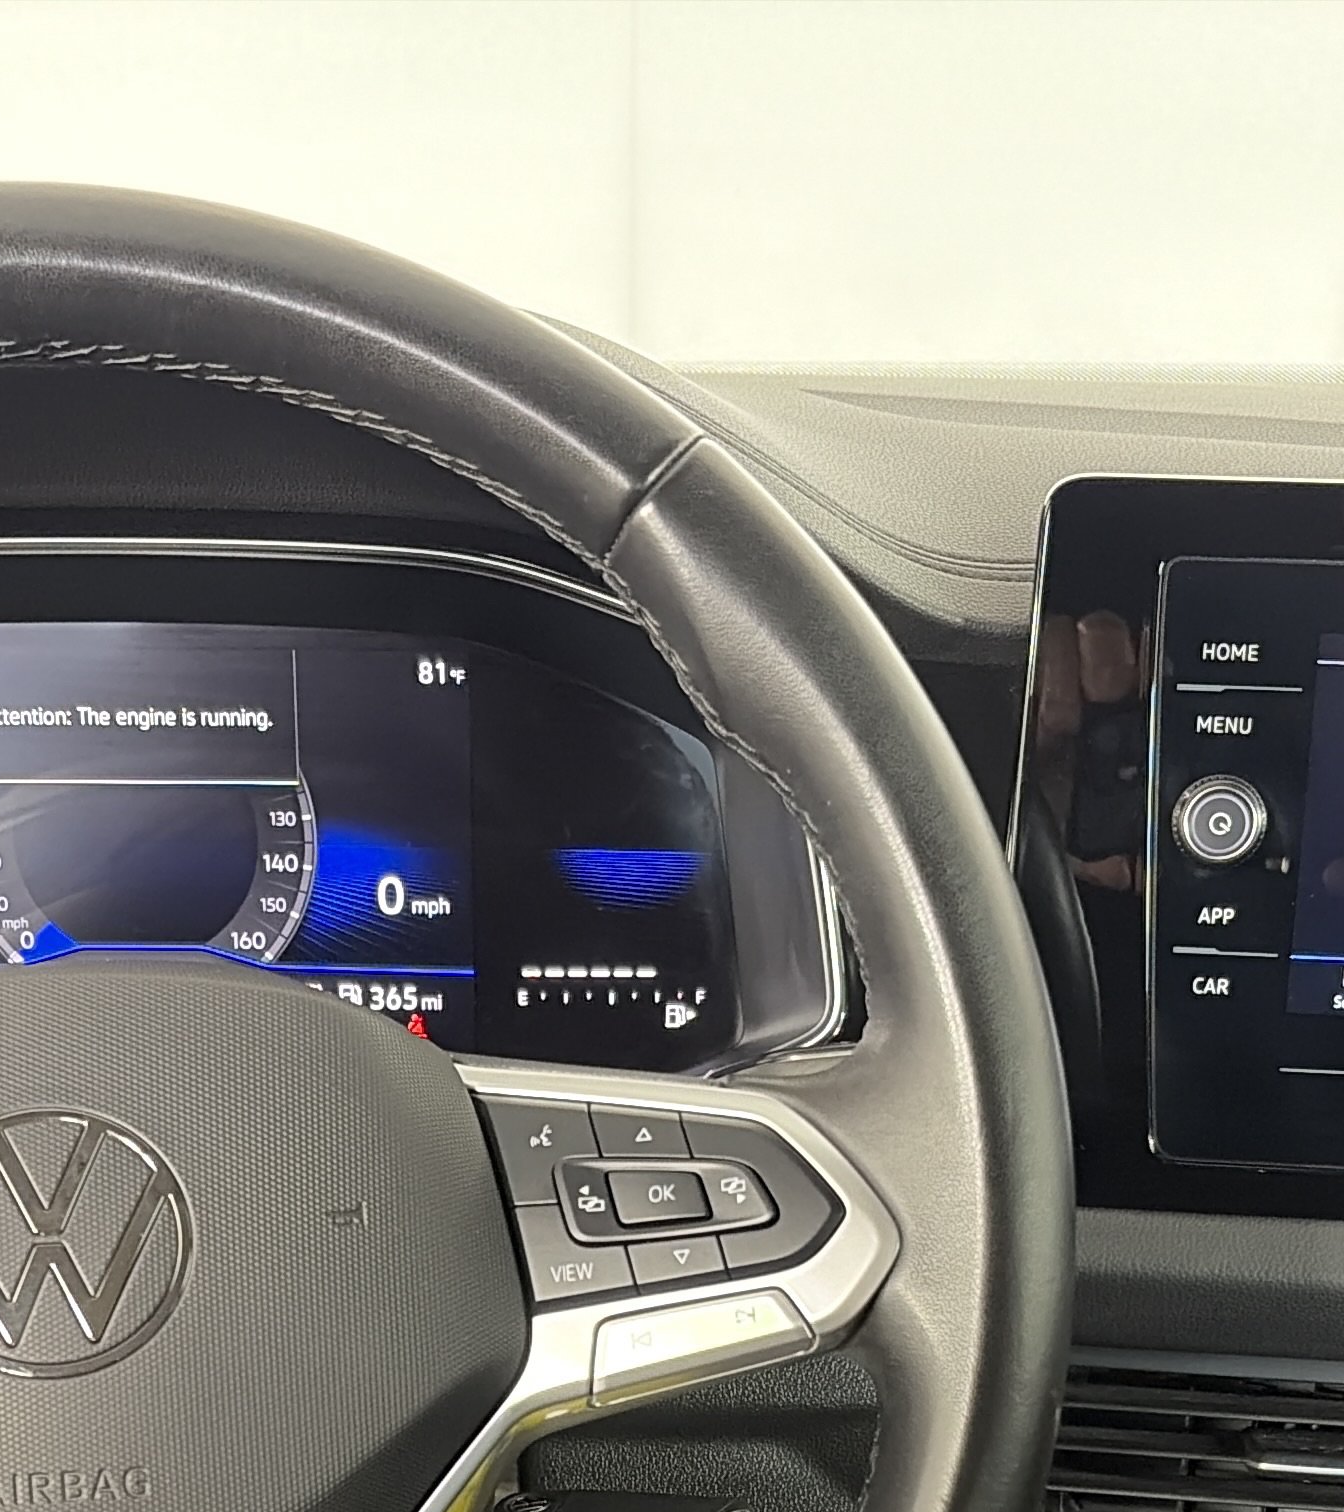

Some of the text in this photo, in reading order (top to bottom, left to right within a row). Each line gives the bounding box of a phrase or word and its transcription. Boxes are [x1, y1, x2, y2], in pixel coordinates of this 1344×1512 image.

[1202, 643, 1260, 662] HOME
[77, 707, 111, 726] The
[115, 709, 177, 731] engine
[182, 709, 198, 727] is
[200, 709, 273, 731] running.
[1196, 716, 1253, 736] MENU
[269, 811, 297, 827] 130
[263, 854, 299, 873] 140
[260, 896, 287, 913] 150
[377, 875, 452, 919] 0 mph
[2, 917, 29, 932] mph
[1198, 907, 1235, 925] APP
[20, 931, 35, 951] 0
[231, 931, 266, 950] 160
[1192, 977, 1230, 996] CAR
[369, 985, 443, 1011] 365 mi
[517, 990, 529, 1005] E
[696, 989, 706, 1004] F
[648, 1185, 676, 1202] OK
[551, 1264, 593, 1282] VIEW
